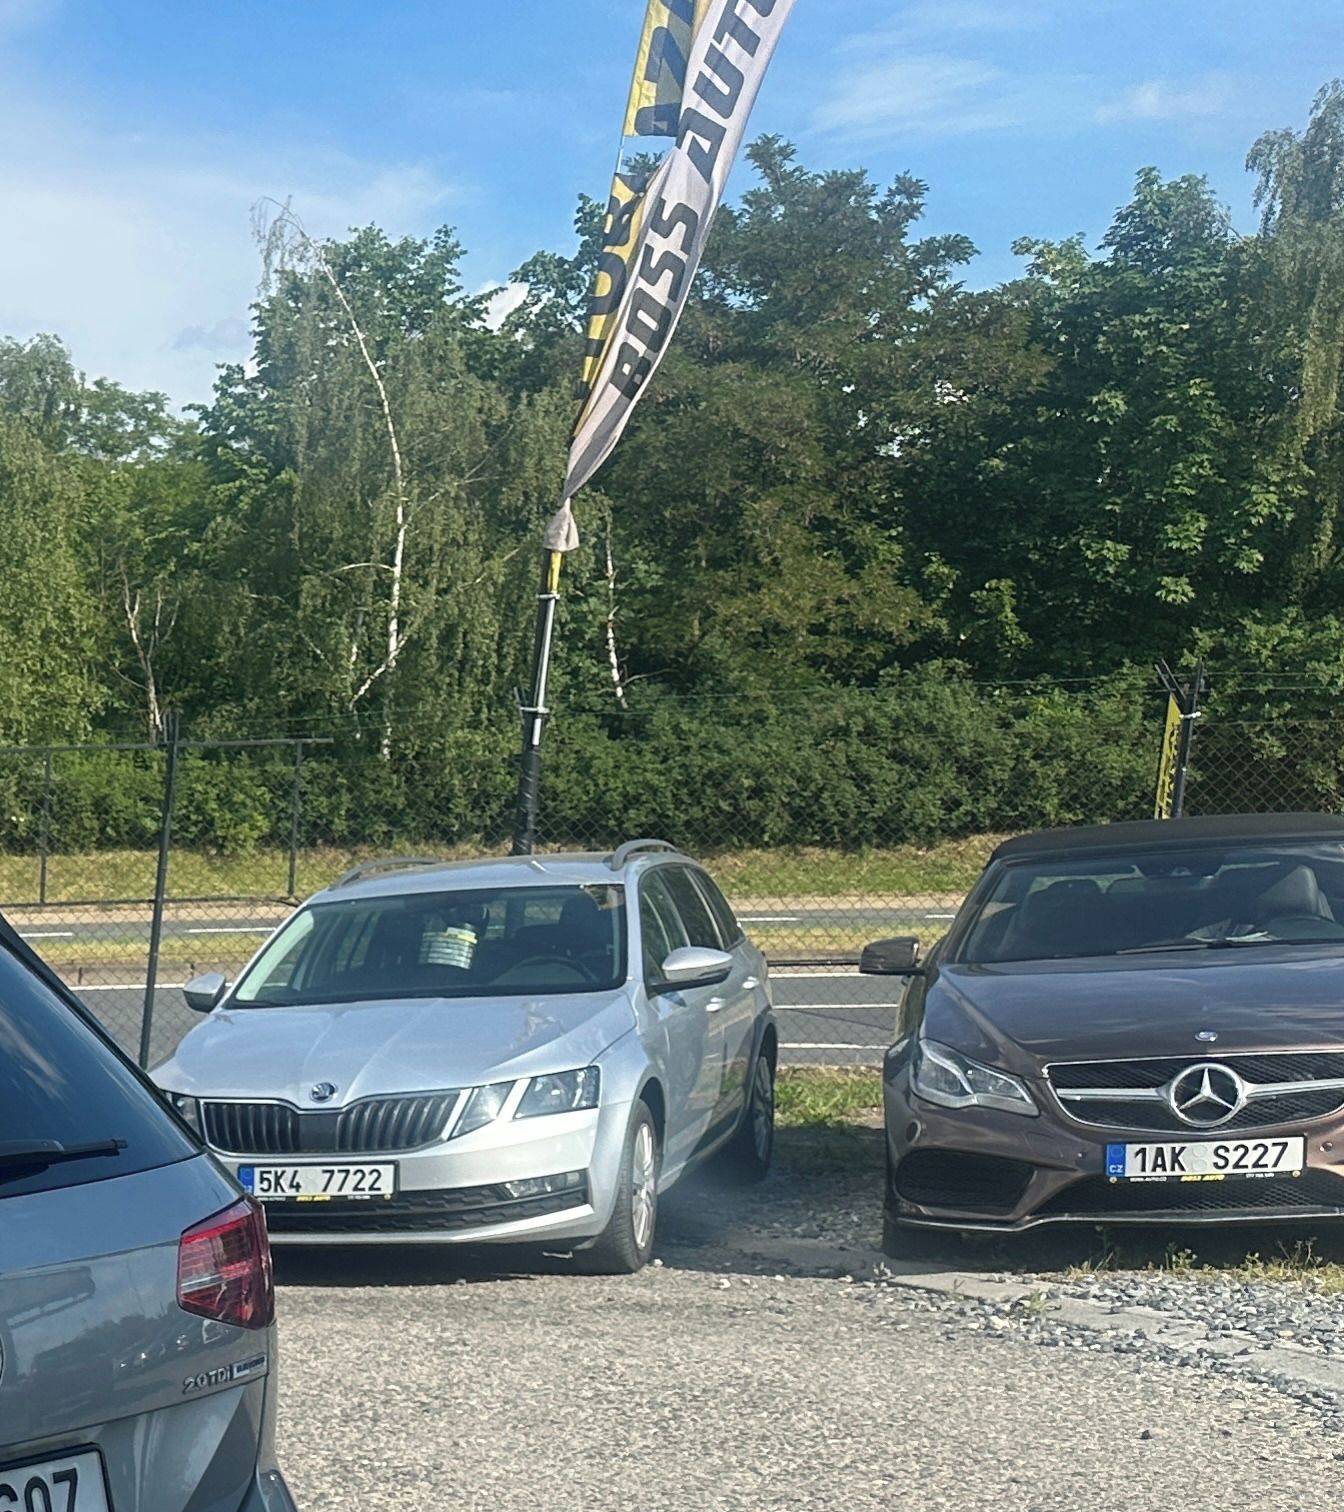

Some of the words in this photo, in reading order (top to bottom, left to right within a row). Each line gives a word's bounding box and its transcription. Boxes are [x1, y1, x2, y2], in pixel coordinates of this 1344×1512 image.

[610, 197, 698, 399] BOSS
[1109, 1164, 1124, 1173] CZ
[1134, 1145, 1188, 1173] 1AK
[1212, 1141, 1289, 1170] S227
[259, 1170, 302, 1193] 5K4
[321, 1169, 382, 1193] 7722
